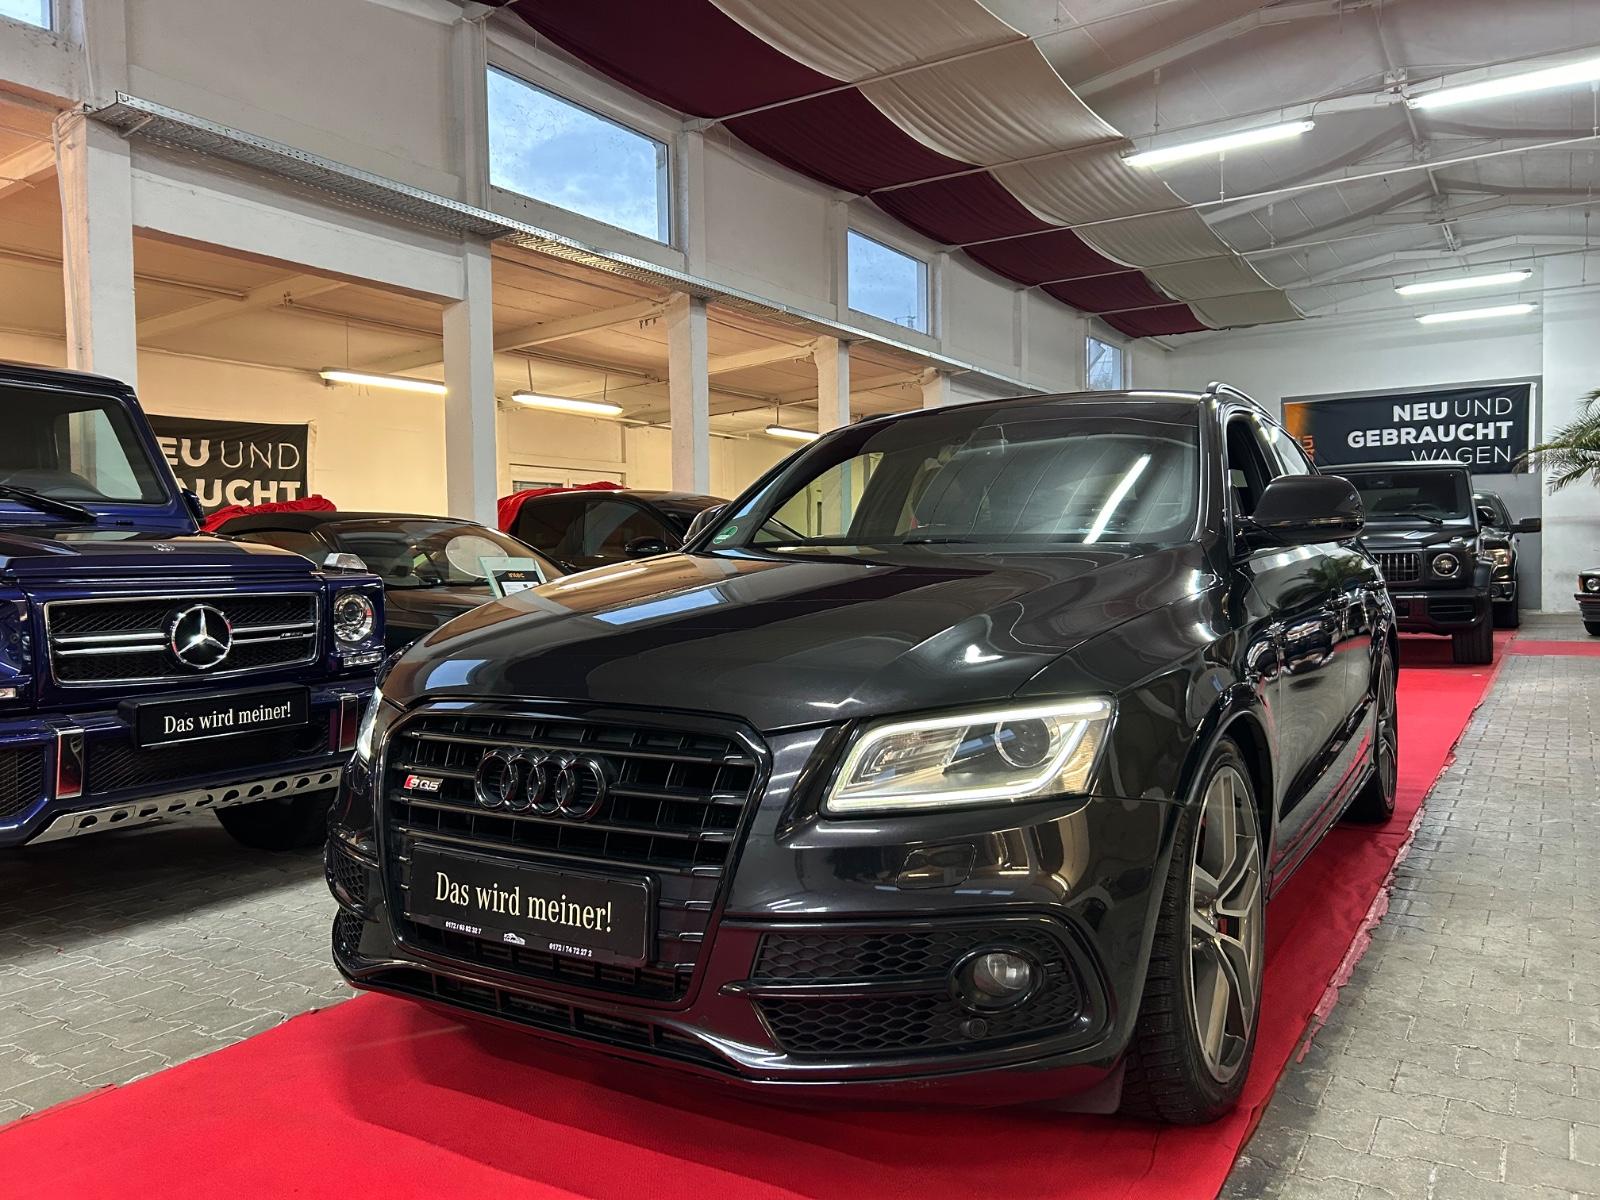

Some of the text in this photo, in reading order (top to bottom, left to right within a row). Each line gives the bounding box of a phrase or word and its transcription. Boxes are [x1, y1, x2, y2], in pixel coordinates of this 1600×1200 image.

[1393, 397, 1513, 422] NEU UND
[1347, 421, 1514, 449] GEBRAUCHT
[155, 436, 300, 470] EU UND
[1411, 445, 1511, 465] WAGEN
[163, 701, 291, 734] Das wird meiner!
[435, 871, 613, 933] Das wird meiner!
